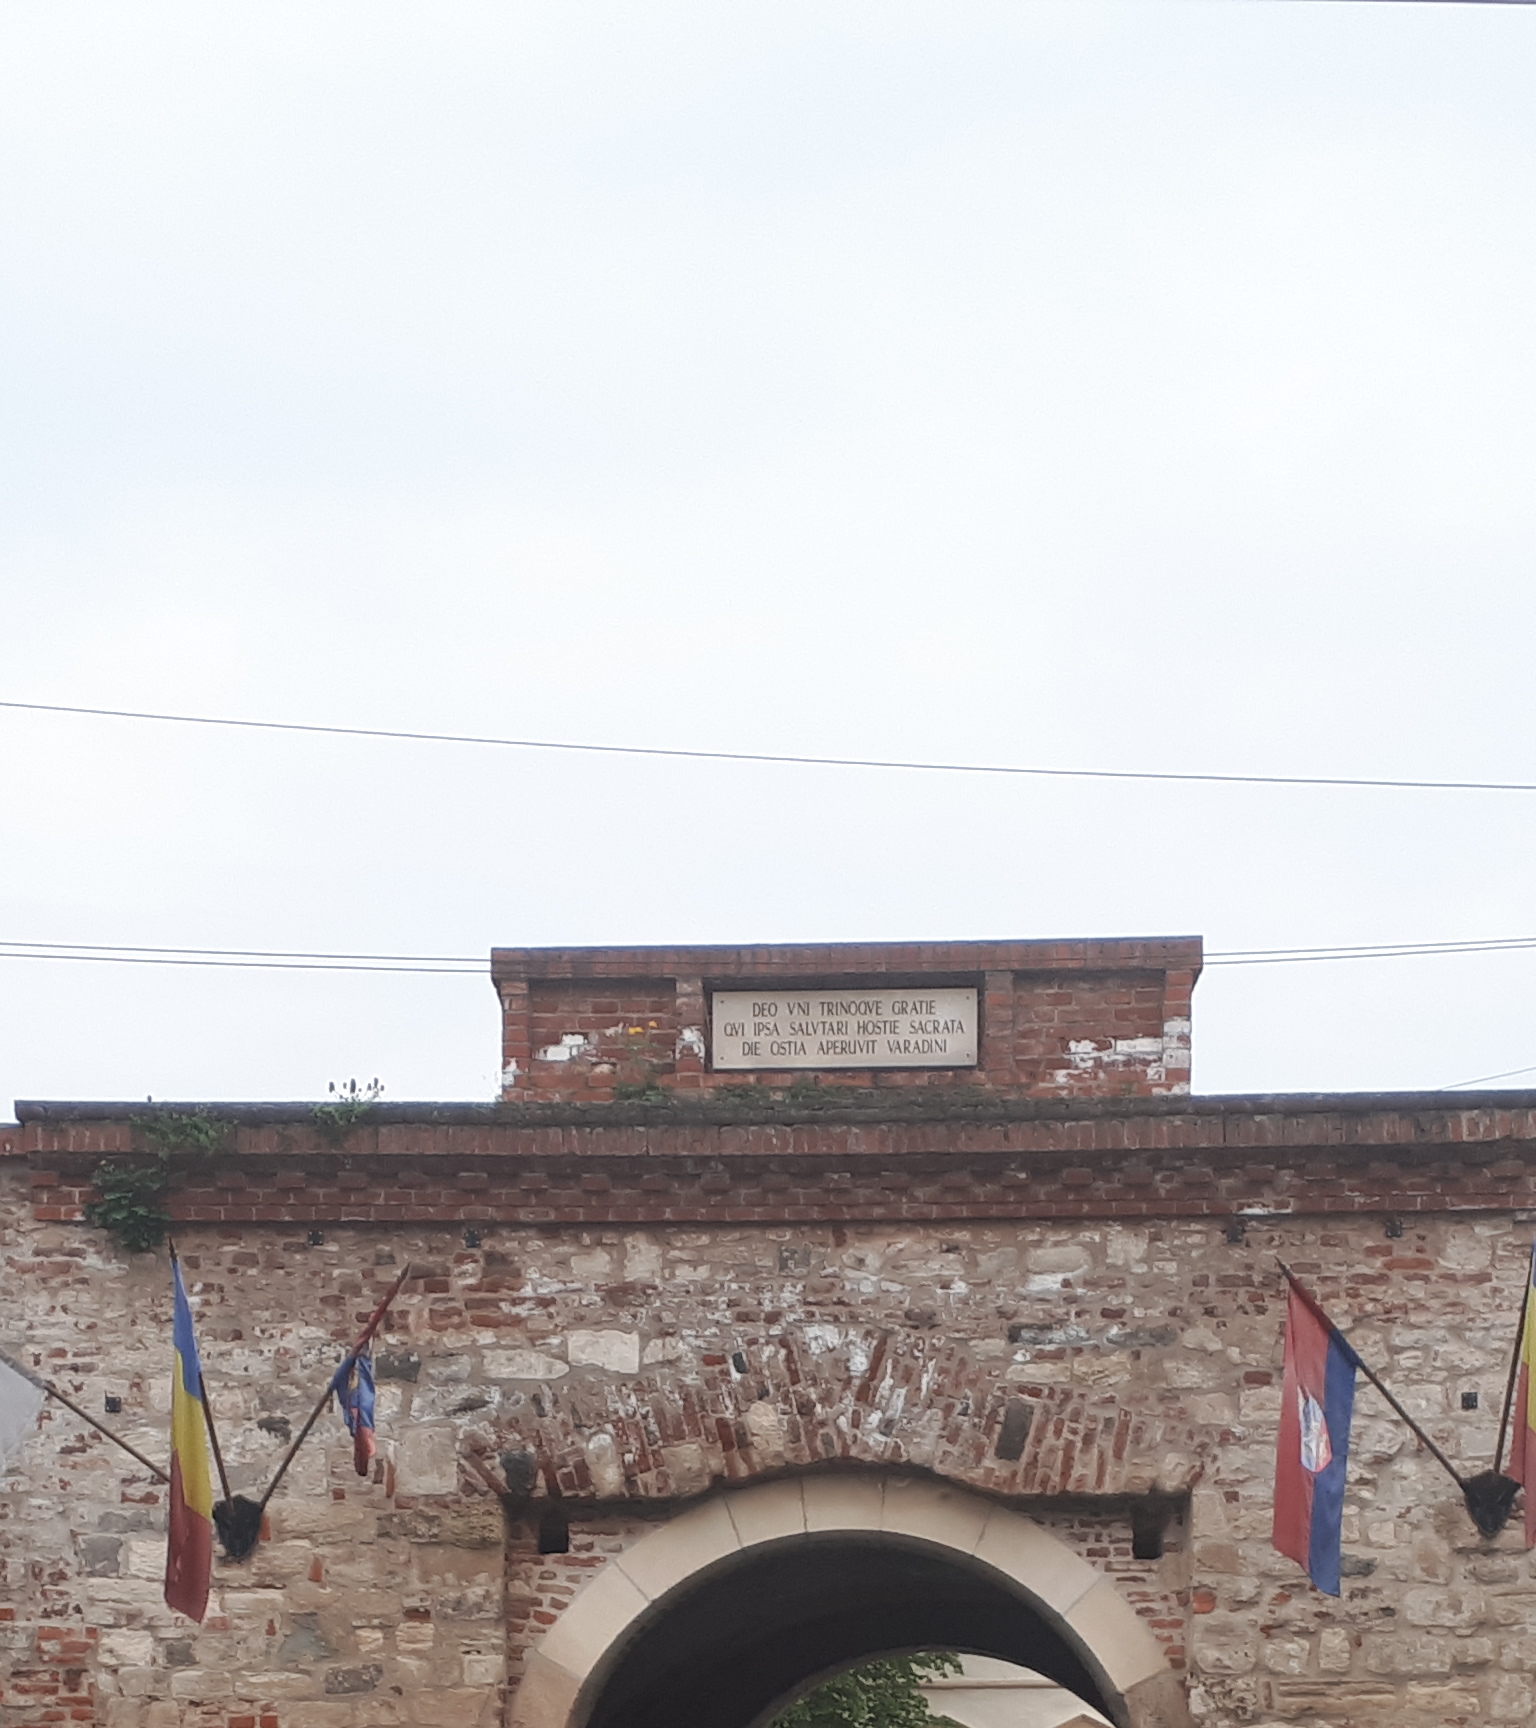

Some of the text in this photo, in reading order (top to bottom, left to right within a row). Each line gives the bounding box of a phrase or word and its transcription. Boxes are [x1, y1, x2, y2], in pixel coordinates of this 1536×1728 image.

[752, 1002, 778, 1018] DEO
[787, 1001, 810, 1016] VNI
[820, 1000, 883, 1016] TRINOQVE
[724, 1022, 745, 1037] QVI
[753, 1022, 780, 1036] IPSA
[789, 1020, 848, 1036] SALVTARI
[909, 1019, 964, 1034] SACRATA
[742, 1041, 761, 1056] DIE
[770, 1040, 806, 1056] OSTIA
[887, 1038, 947, 1054] VARADINI
